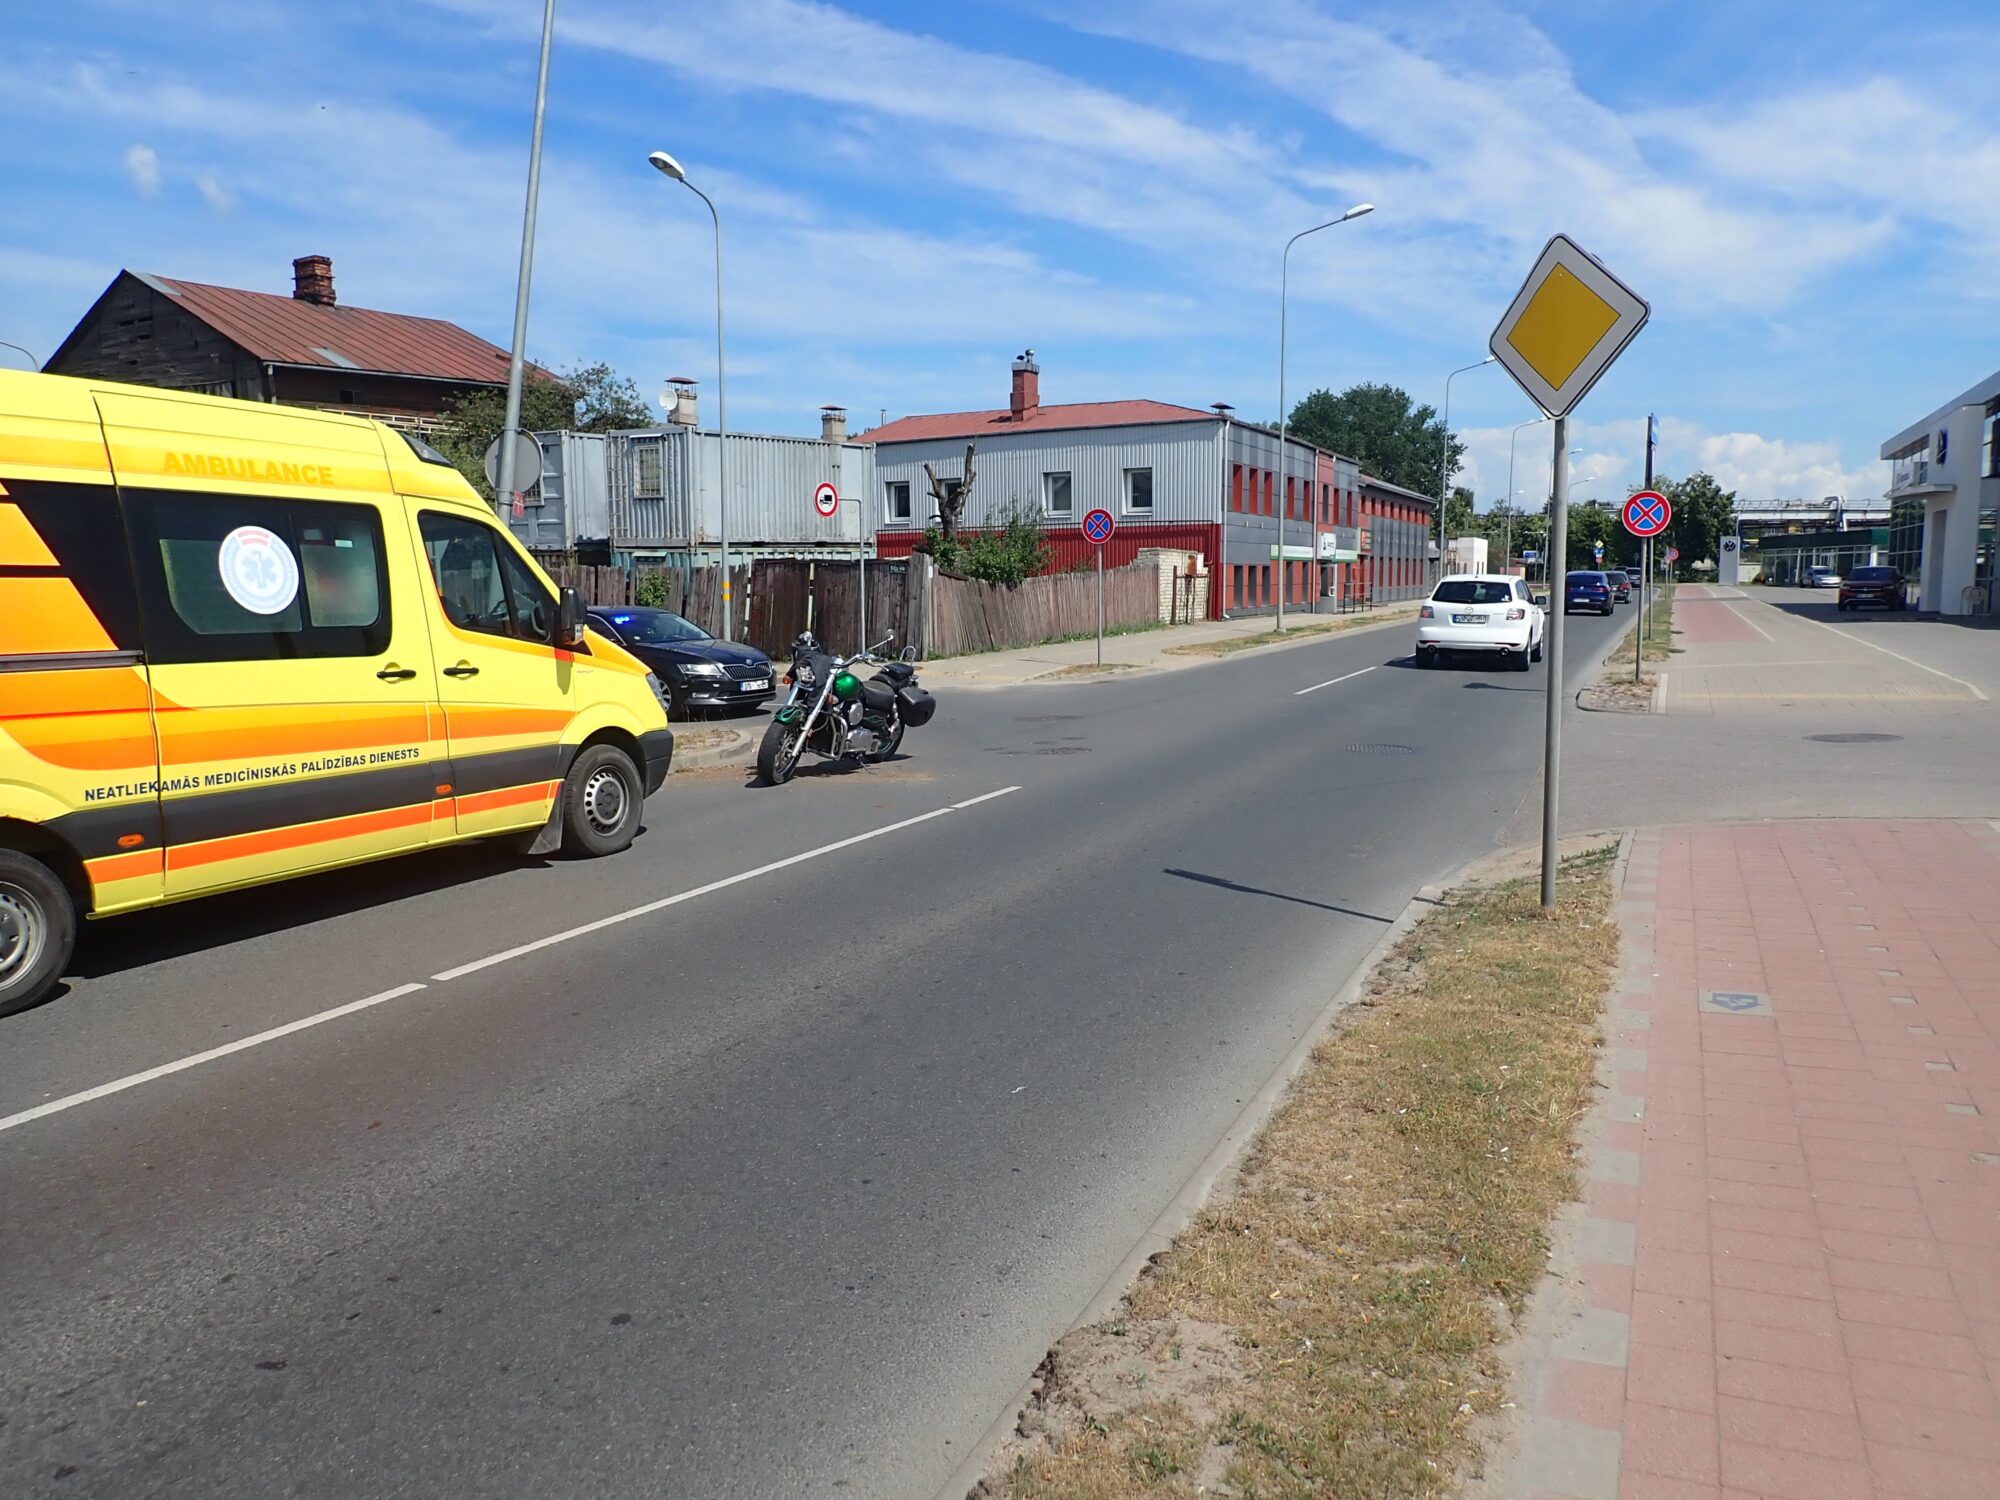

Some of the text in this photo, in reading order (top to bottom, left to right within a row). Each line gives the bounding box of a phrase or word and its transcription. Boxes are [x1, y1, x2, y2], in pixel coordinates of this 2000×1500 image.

[164, 452, 335, 485] AMBULANCE
[84, 748, 420, 801] NEATLIEKAMĀS MEDICĪNISKĀS PALĪDZĪBAS DIENESTS
